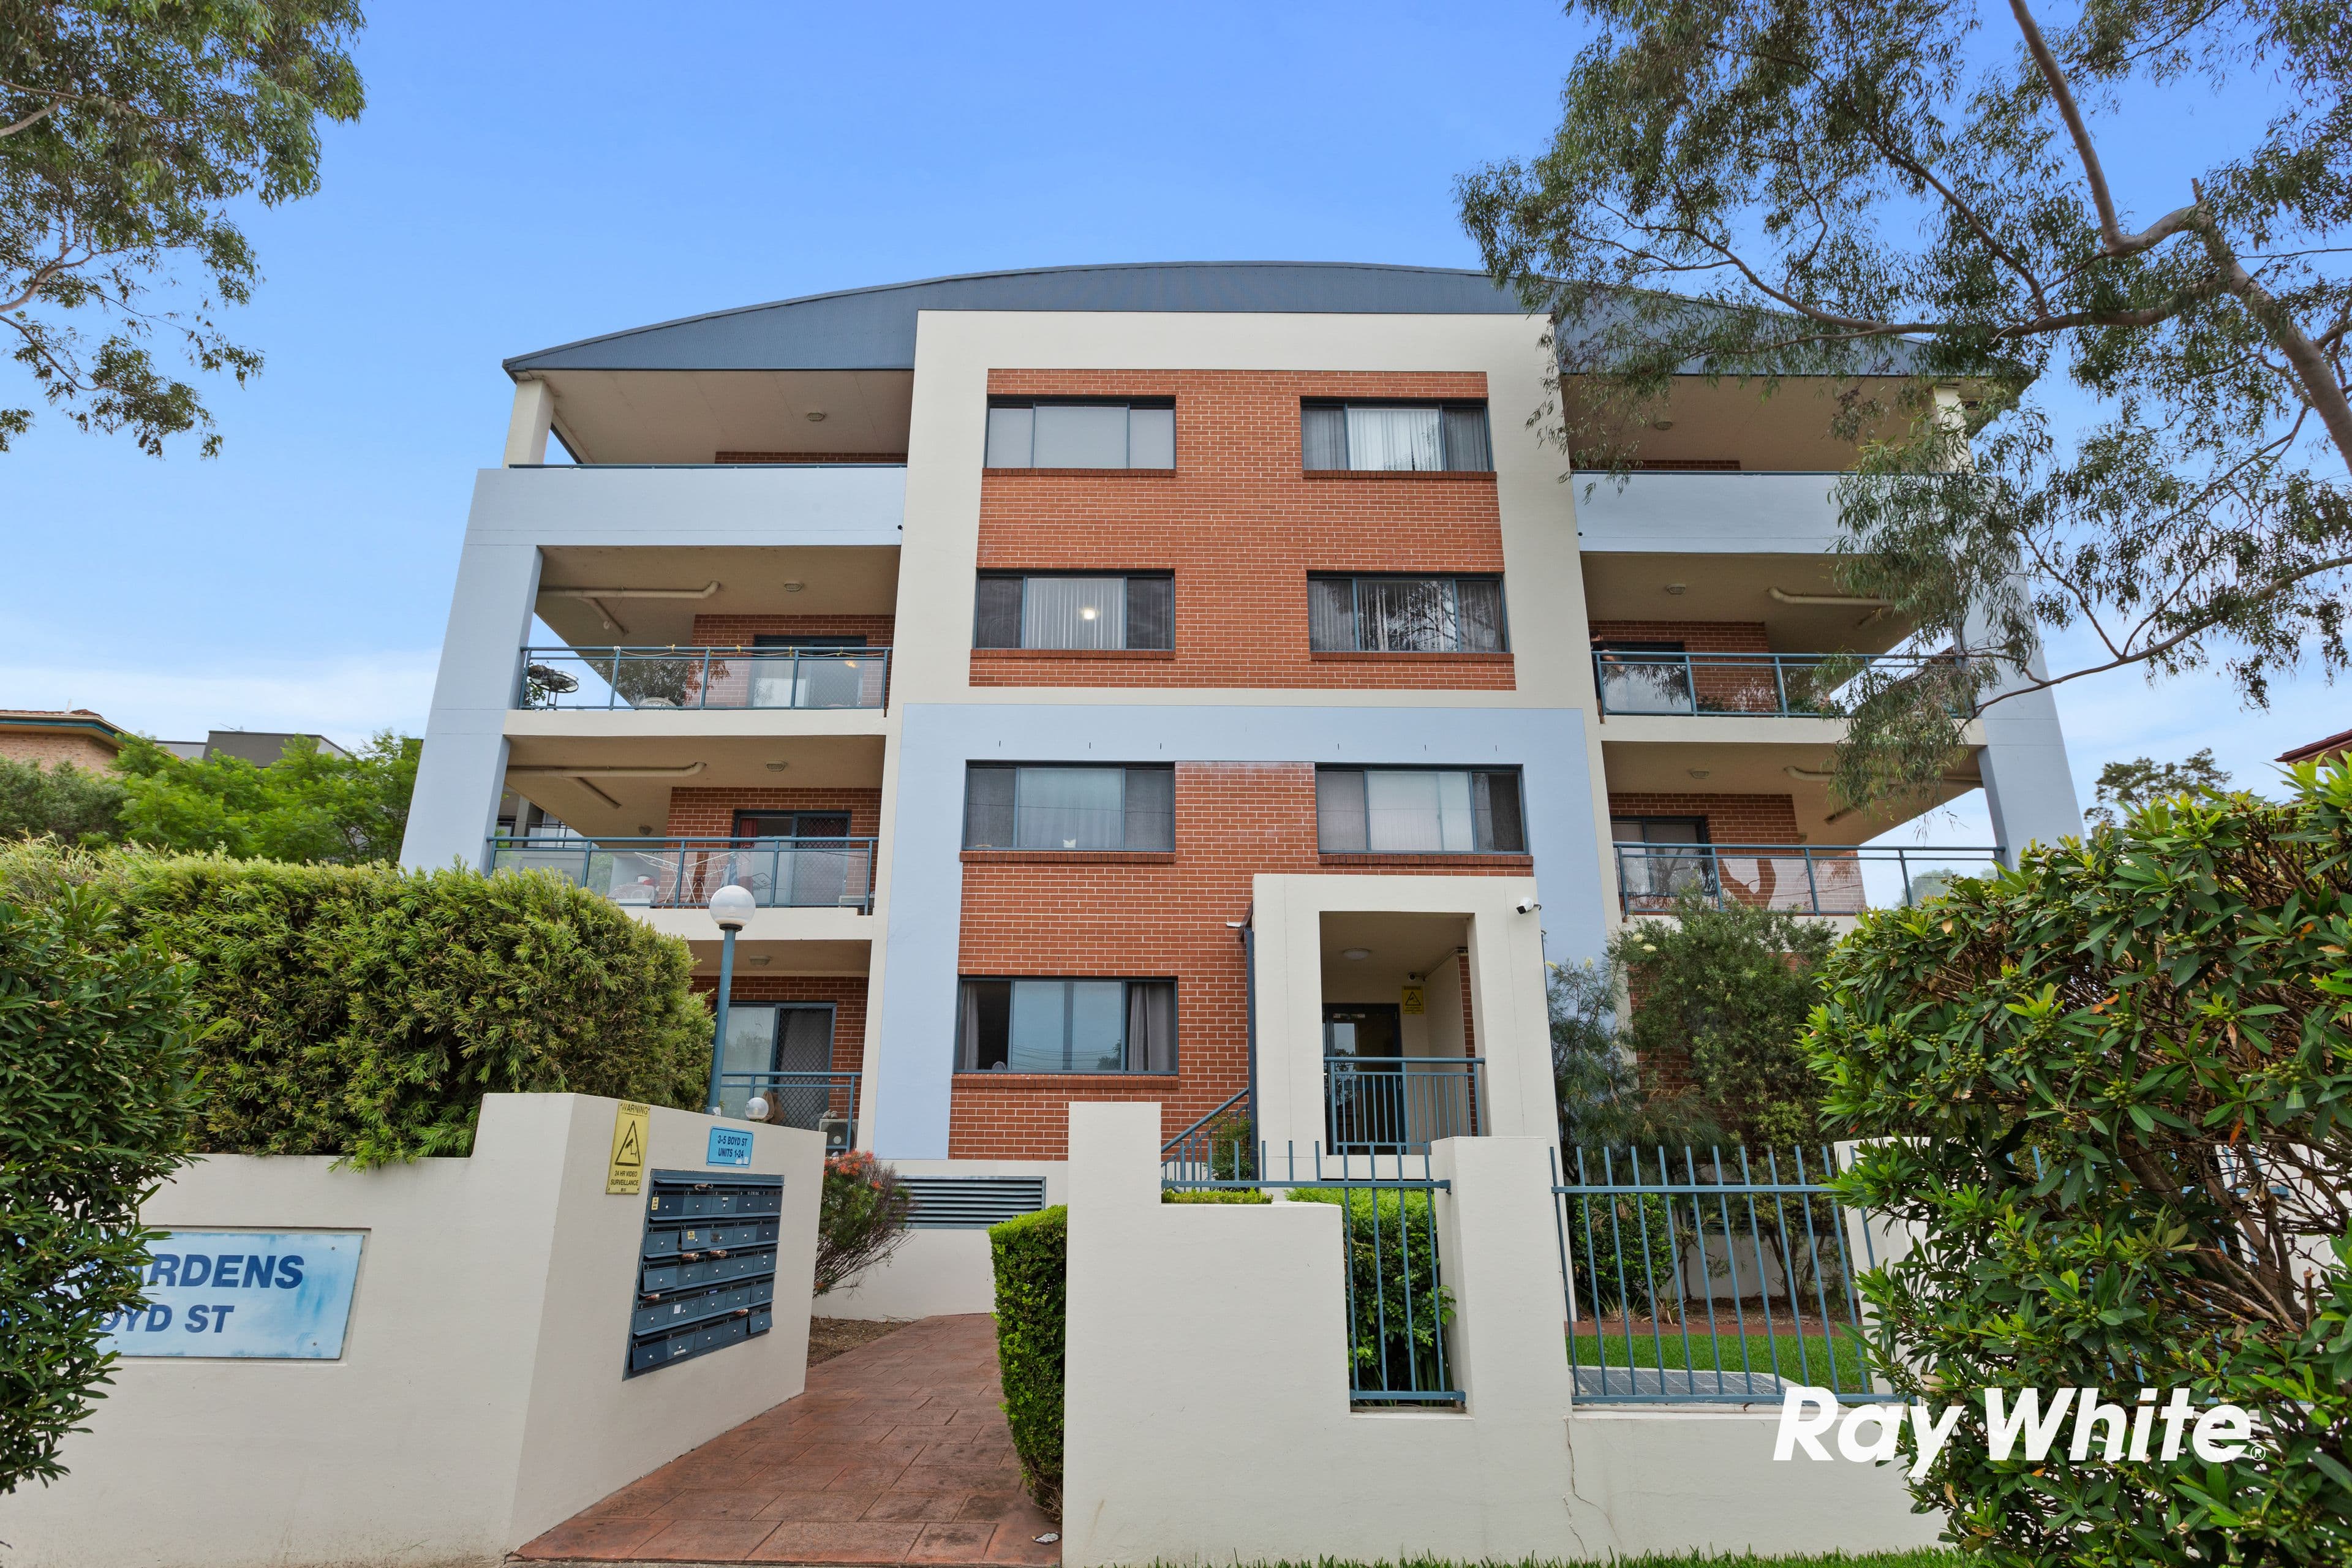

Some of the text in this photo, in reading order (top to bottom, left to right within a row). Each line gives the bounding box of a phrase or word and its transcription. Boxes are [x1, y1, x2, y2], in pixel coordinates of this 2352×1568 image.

[621, 1104, 648, 1115] WARNING
[717, 1135, 748, 1147] 3-5 BOYD ST
[718, 1147, 744, 1158] UNITS 1-24
[185, 1305, 234, 1333] ST
